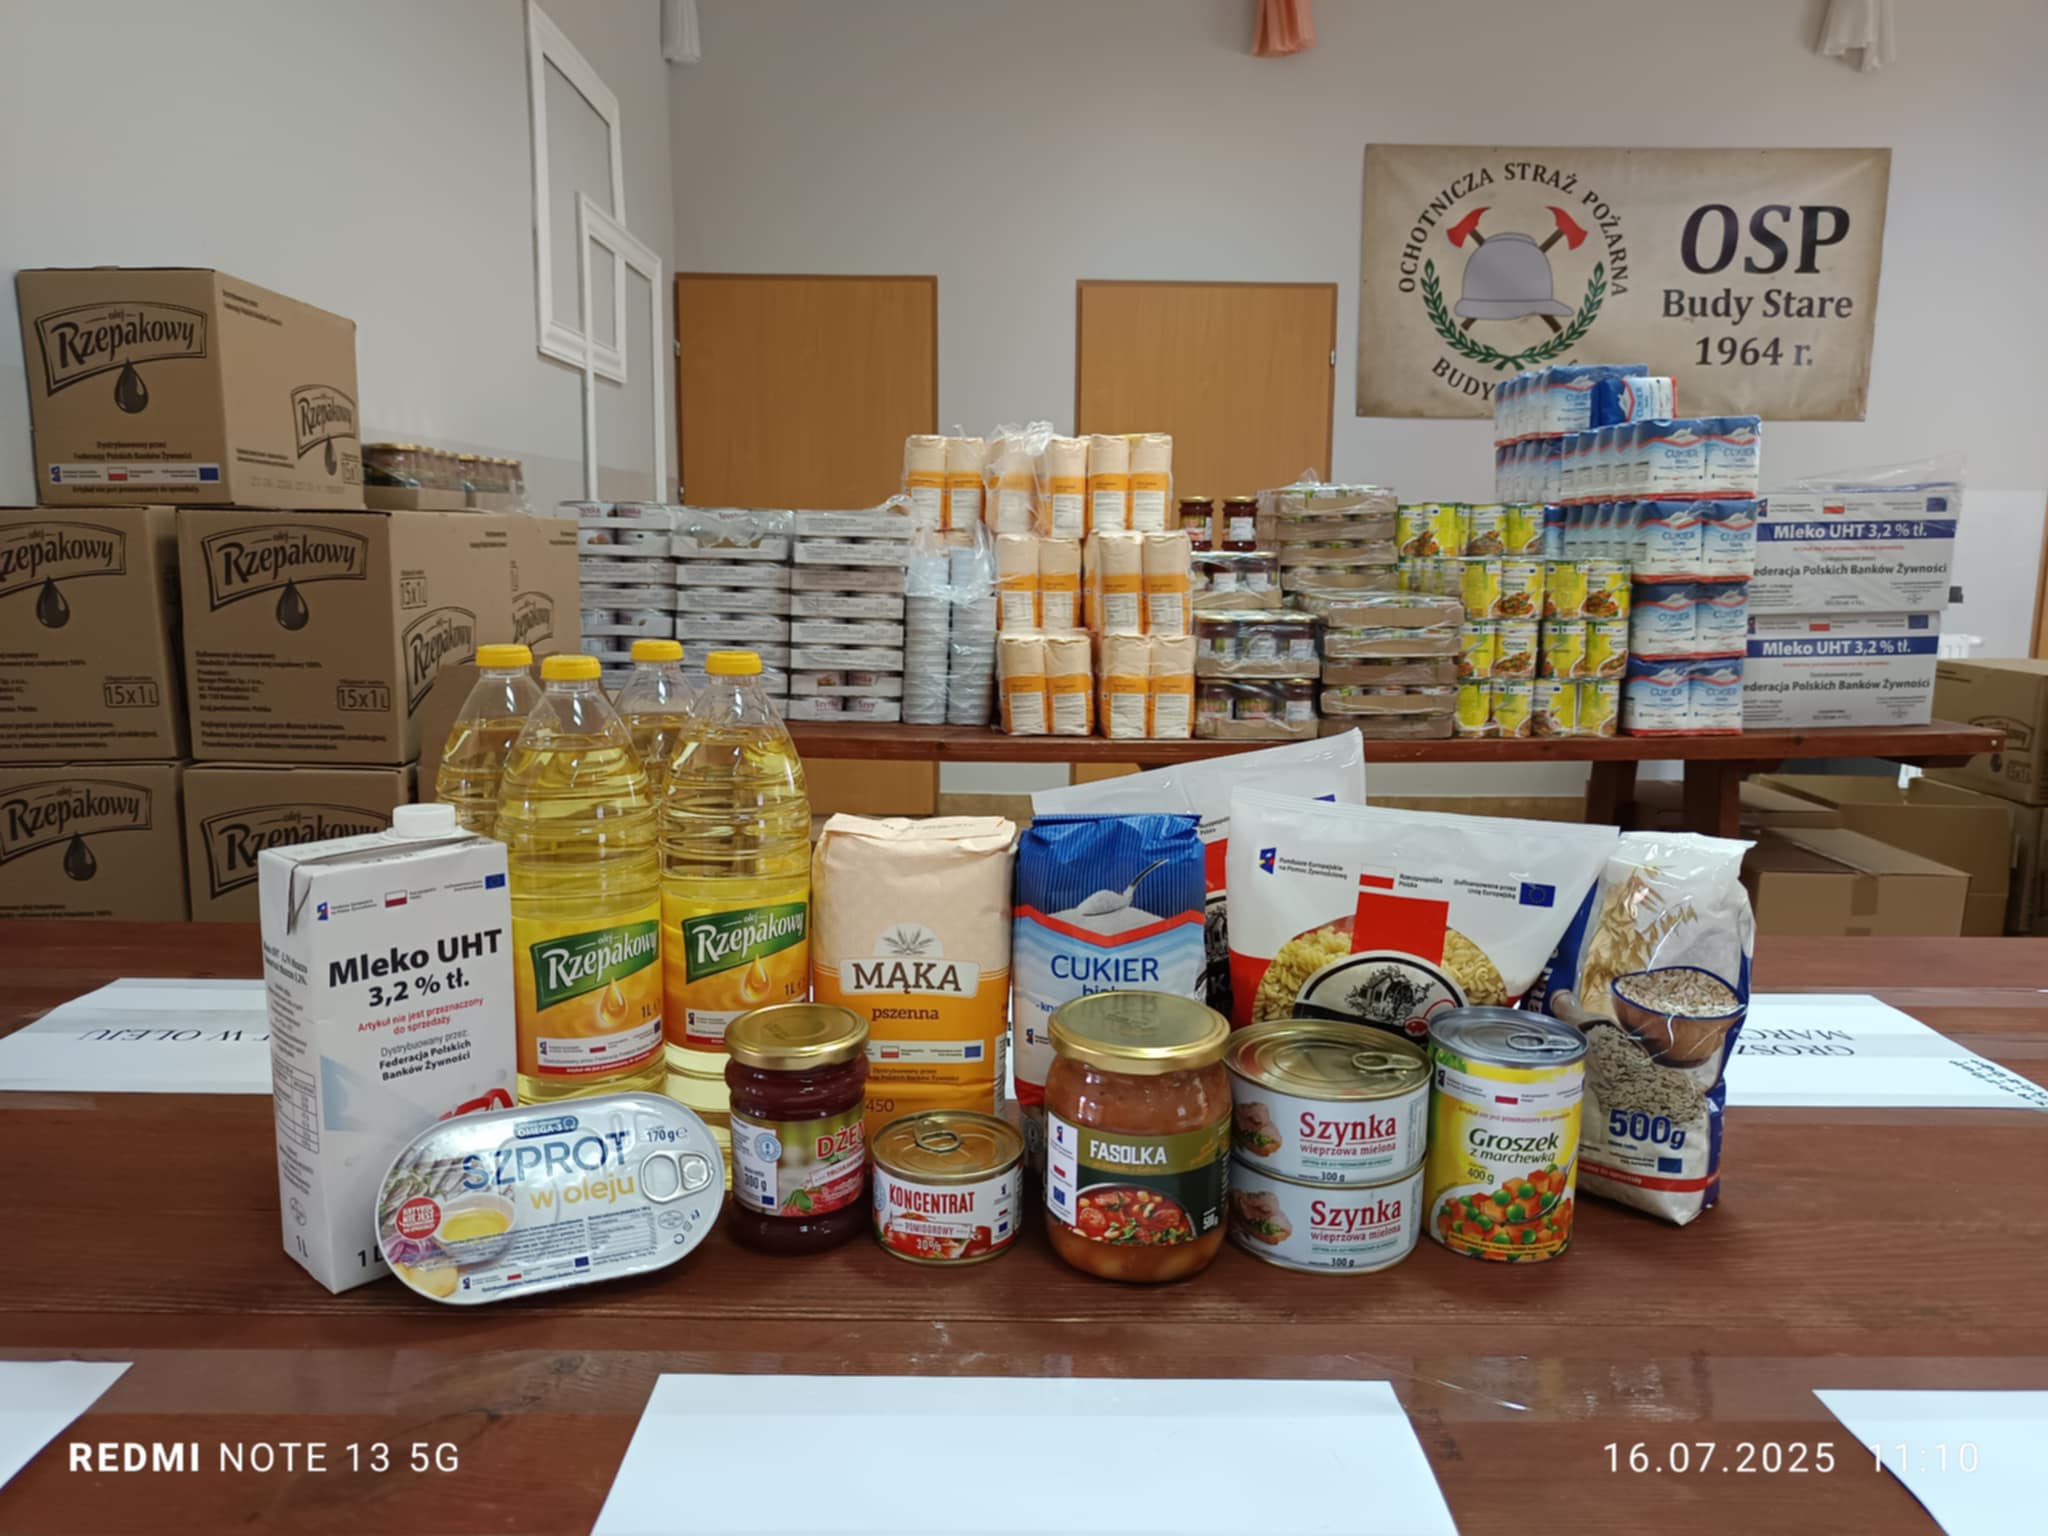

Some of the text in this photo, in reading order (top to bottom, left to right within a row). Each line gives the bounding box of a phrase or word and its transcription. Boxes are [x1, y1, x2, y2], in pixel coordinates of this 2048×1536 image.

[1398, 162, 1629, 296] OCHOTNICZA STRAŻ POŻARNA
[1681, 204, 1850, 274] OSP
[1662, 288, 1853, 326] Budy Stare
[49, 312, 195, 369] Rzepakowy
[1695, 336, 1813, 366] 1964 r.
[1432, 357, 1496, 401] BUDY
[1774, 525, 1826, 540] Mleko
[1829, 524, 1864, 538] UHT
[1868, 525, 1892, 539] 3,2
[1895, 525, 1910, 537] %
[215, 533, 356, 586] Rzepakowy
[1753, 565, 1801, 577] ederacja
[1803, 563, 1848, 576] Polskich
[1850, 562, 1893, 575] Banków
[1763, 642, 1814, 656] Mleko
[1816, 641, 1850, 654] UHT
[1855, 641, 1878, 655] 3,2
[1880, 641, 1895, 653] %
[1743, 682, 1790, 694] ederacja
[1793, 680, 1836, 692] Polskich
[1839, 679, 1880, 691] Banków
[6, 789, 141, 841] Rzepakowy
[692, 912, 804, 964] Rzepakowy
[329, 929, 502, 988] Mleko UHT
[541, 929, 657, 990] Rzepakowy
[1051, 955, 1159, 982] CUKIER
[369, 967, 470, 1007] 3,2 % tł.
[852, 962, 962, 994] MĄKA
[357, 1015, 391, 1032] Artykuł
[392, 1014, 407, 1025] nie
[408, 1010, 425, 1025] jest
[871, 1007, 939, 1021] pszenna
[393, 1025, 406, 1035] do
[379, 1040, 472, 1070] Federacja Polskich
[382, 1051, 471, 1081] Banków Żywności
[866, 1099, 895, 1112] 450
[646, 1129, 666, 1143] 170
[1300, 1112, 1396, 1147] Szynka
[1469, 1127, 1560, 1152] Groszek
[1609, 1109, 1686, 1150] 500g
[462, 1130, 630, 1190] SZPROT
[1090, 1139, 1168, 1165] FASOLKA
[1300, 1142, 1396, 1157] wieprzowa mielona
[1469, 1147, 1478, 1157] z
[1321, 1172, 1337, 1181] 300
[1467, 1167, 1495, 1185] 400 g
[530, 1173, 636, 1210] w oleju
[889, 1183, 975, 1214] KONCENTRAT
[1310, 1199, 1401, 1234] Szynka
[1311, 1224, 1401, 1243] wieprzowa mielona
[1331, 1257, 1347, 1267] 300
